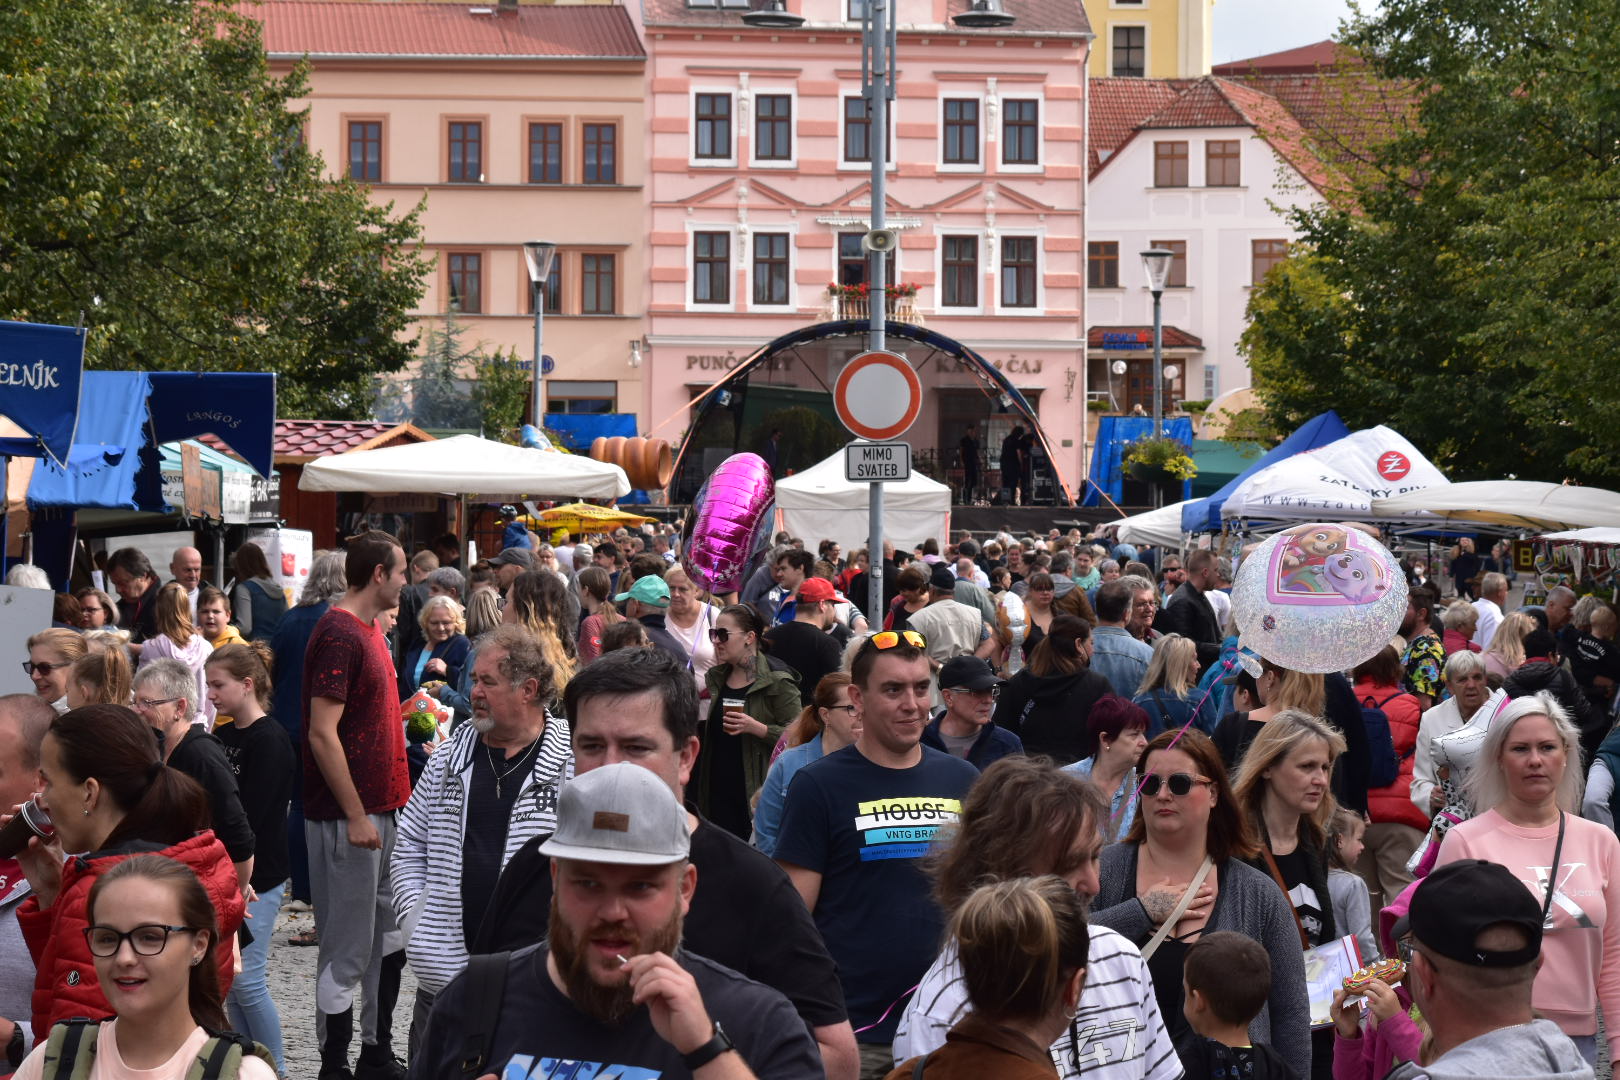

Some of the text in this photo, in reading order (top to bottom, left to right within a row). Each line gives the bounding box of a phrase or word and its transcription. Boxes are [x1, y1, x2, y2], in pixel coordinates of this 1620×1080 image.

[686, 350, 794, 371] PUNČHY
[1006, 354, 1043, 374] ČAJ
[0, 360, 60, 390] ELNÍK
[863, 447, 892, 461] MIMO
[857, 463, 898, 477] SVATEB
[1382, 454, 1407, 475] Ž
[872, 802, 949, 822] HOUSE
[885, 829, 939, 840] VNTG BRA
